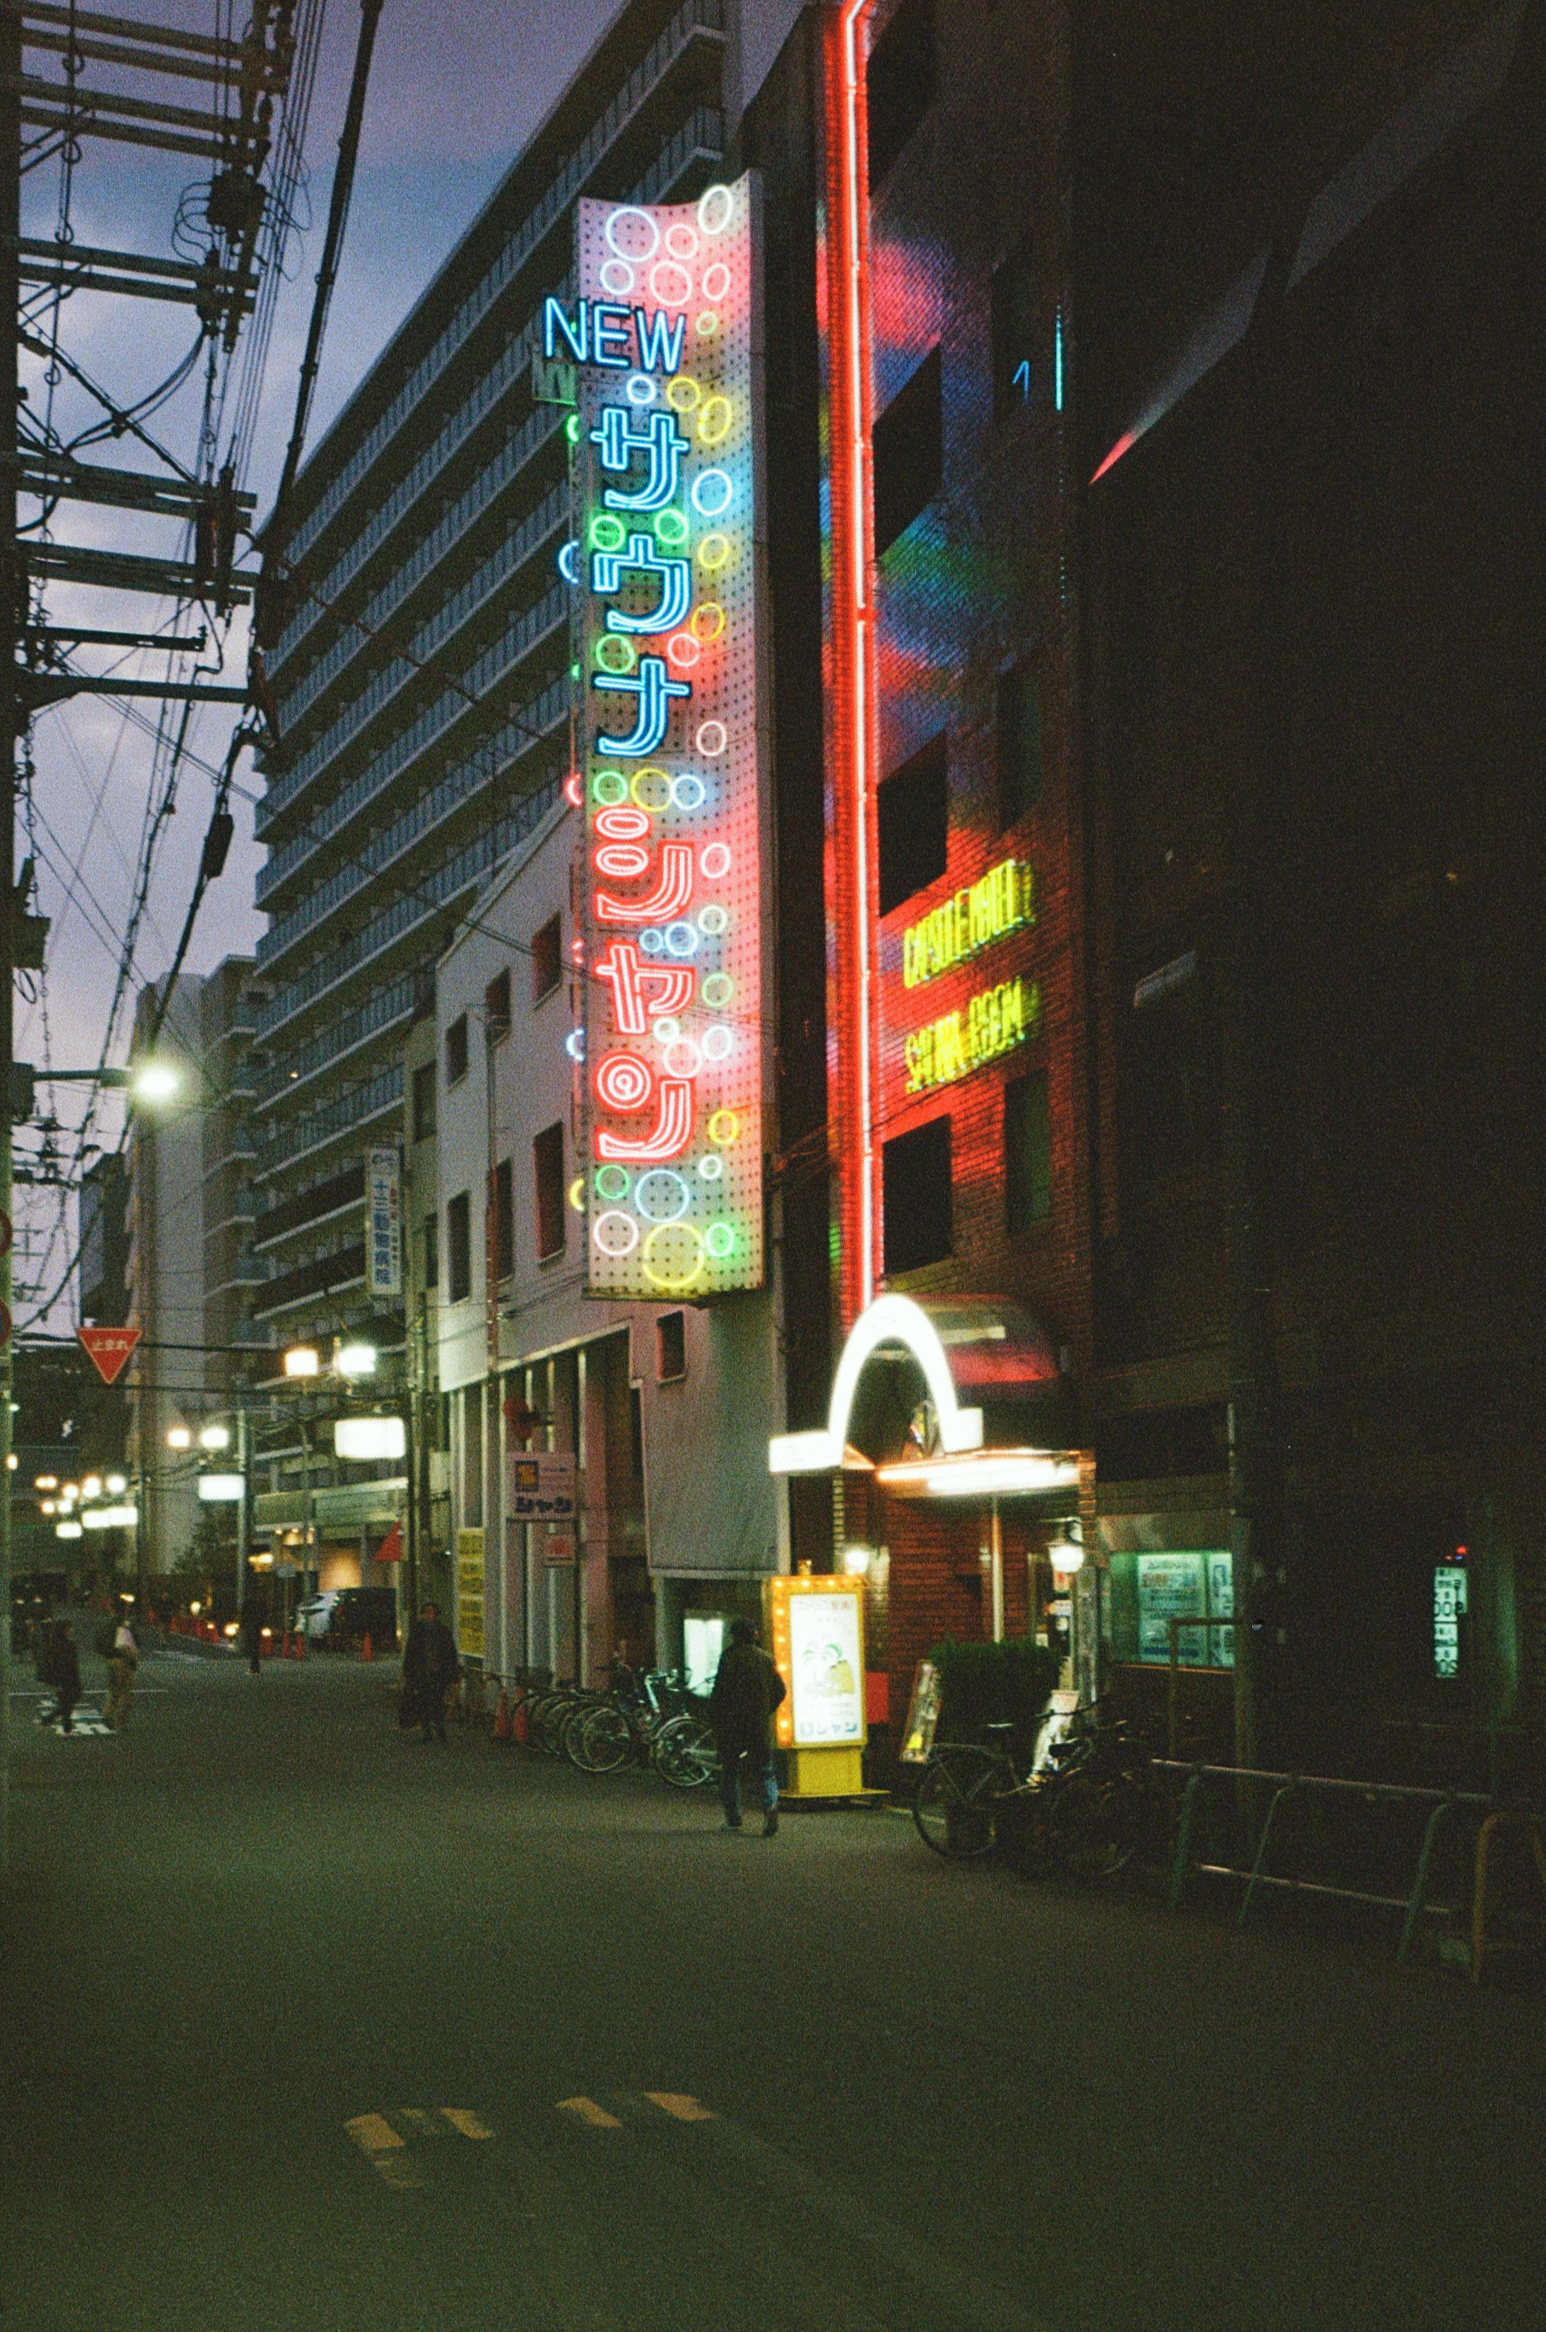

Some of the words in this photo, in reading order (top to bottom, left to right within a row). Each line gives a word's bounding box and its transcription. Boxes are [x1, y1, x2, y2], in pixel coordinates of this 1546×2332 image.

[544, 296, 686, 375] NEW
[590, 407, 690, 757] サウナ
[92, 1339, 128, 1350] 止まれ
